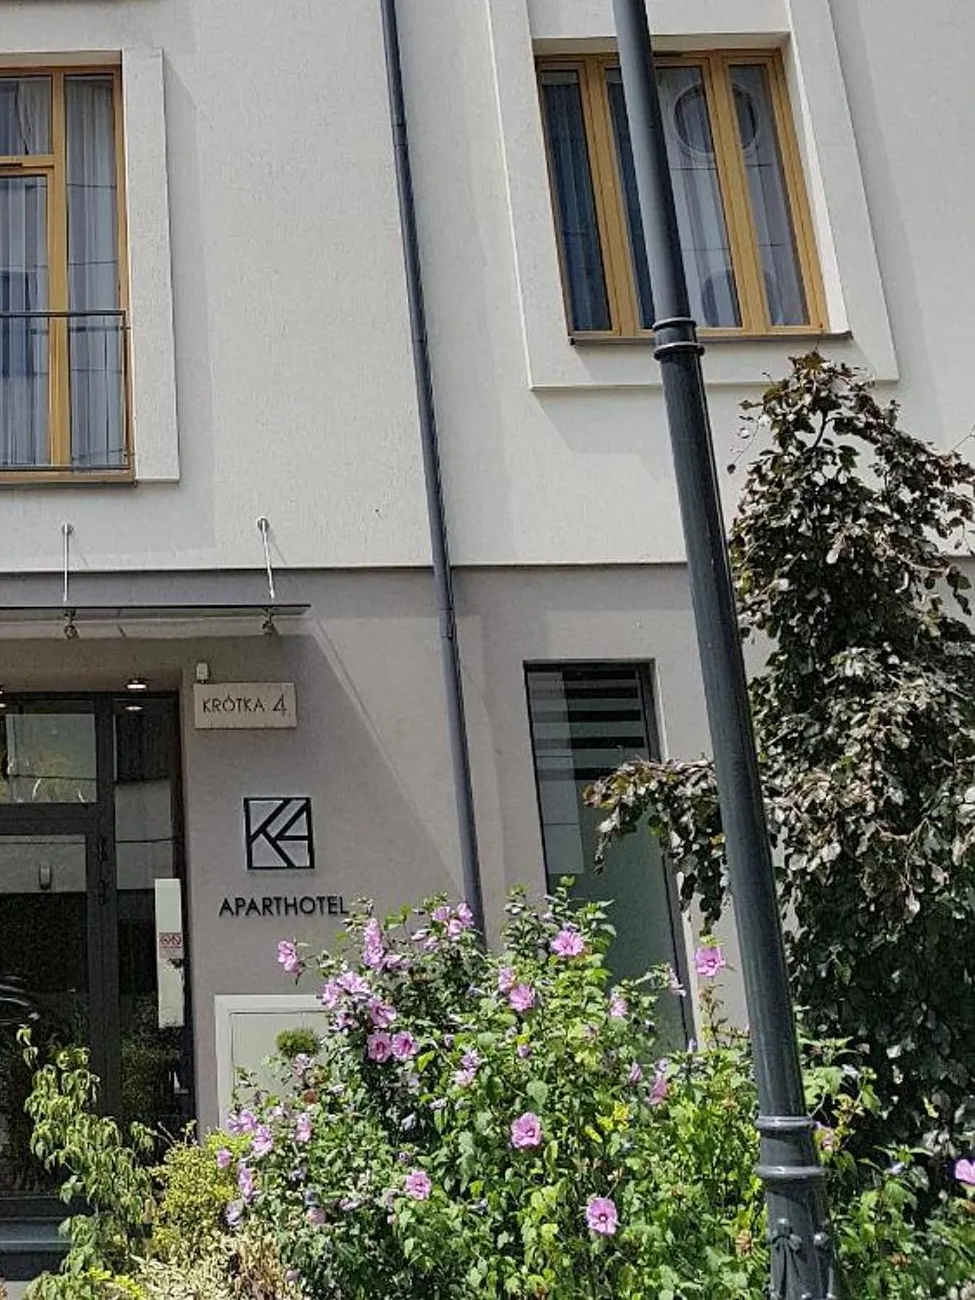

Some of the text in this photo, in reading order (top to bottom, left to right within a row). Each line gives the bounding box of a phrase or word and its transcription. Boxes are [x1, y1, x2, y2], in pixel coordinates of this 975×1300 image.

[202, 693, 287, 717] KRÓTKA 4
[218, 895, 351, 917] APARTHOTEL
